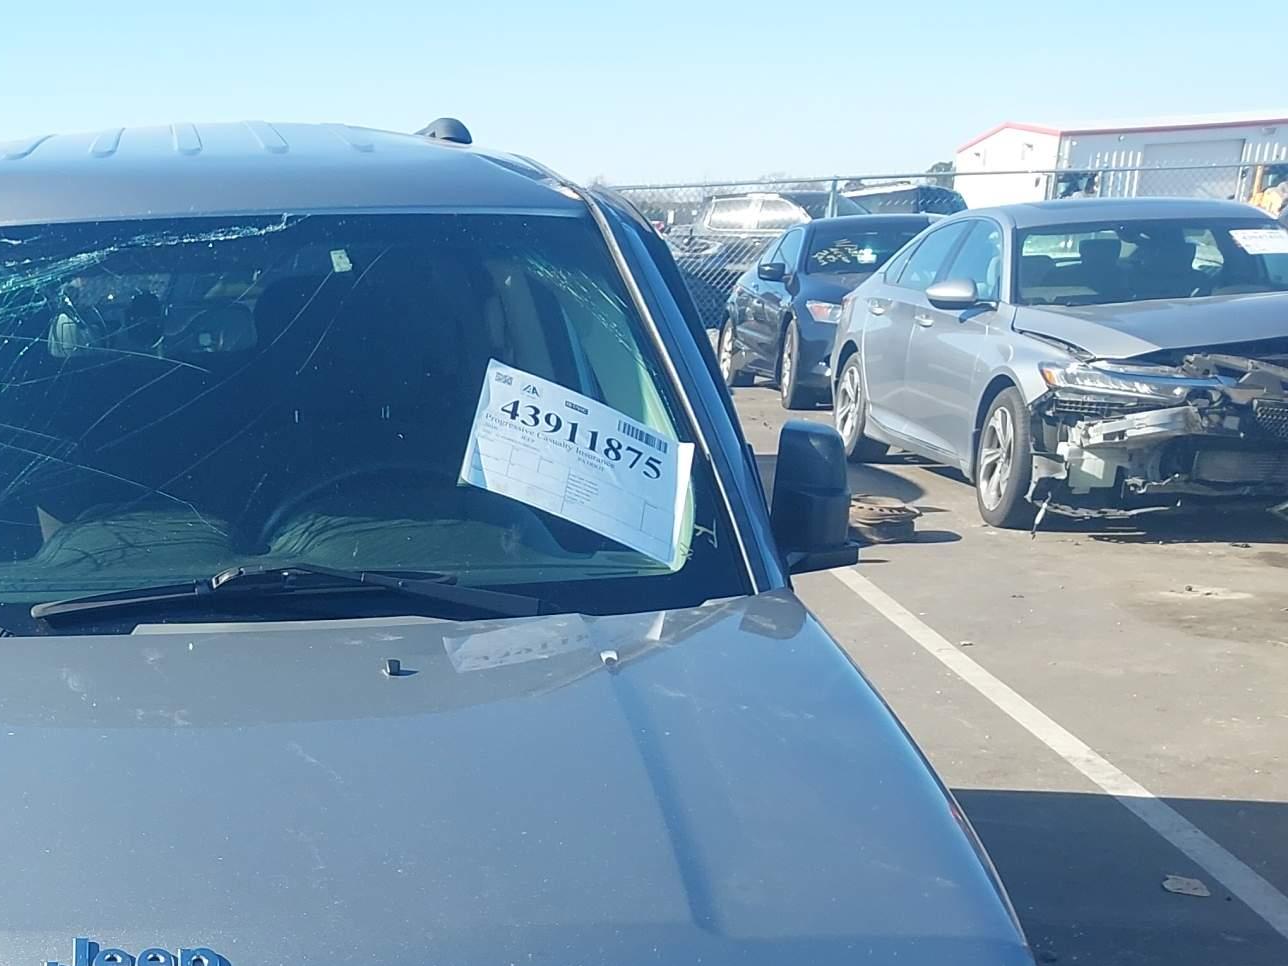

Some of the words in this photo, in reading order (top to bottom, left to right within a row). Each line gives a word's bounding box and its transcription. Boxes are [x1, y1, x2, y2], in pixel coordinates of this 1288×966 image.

[485, 412, 535, 437] Progressive
[536, 431, 573, 453] Casualty
[500, 399, 663, 480] 43911875
